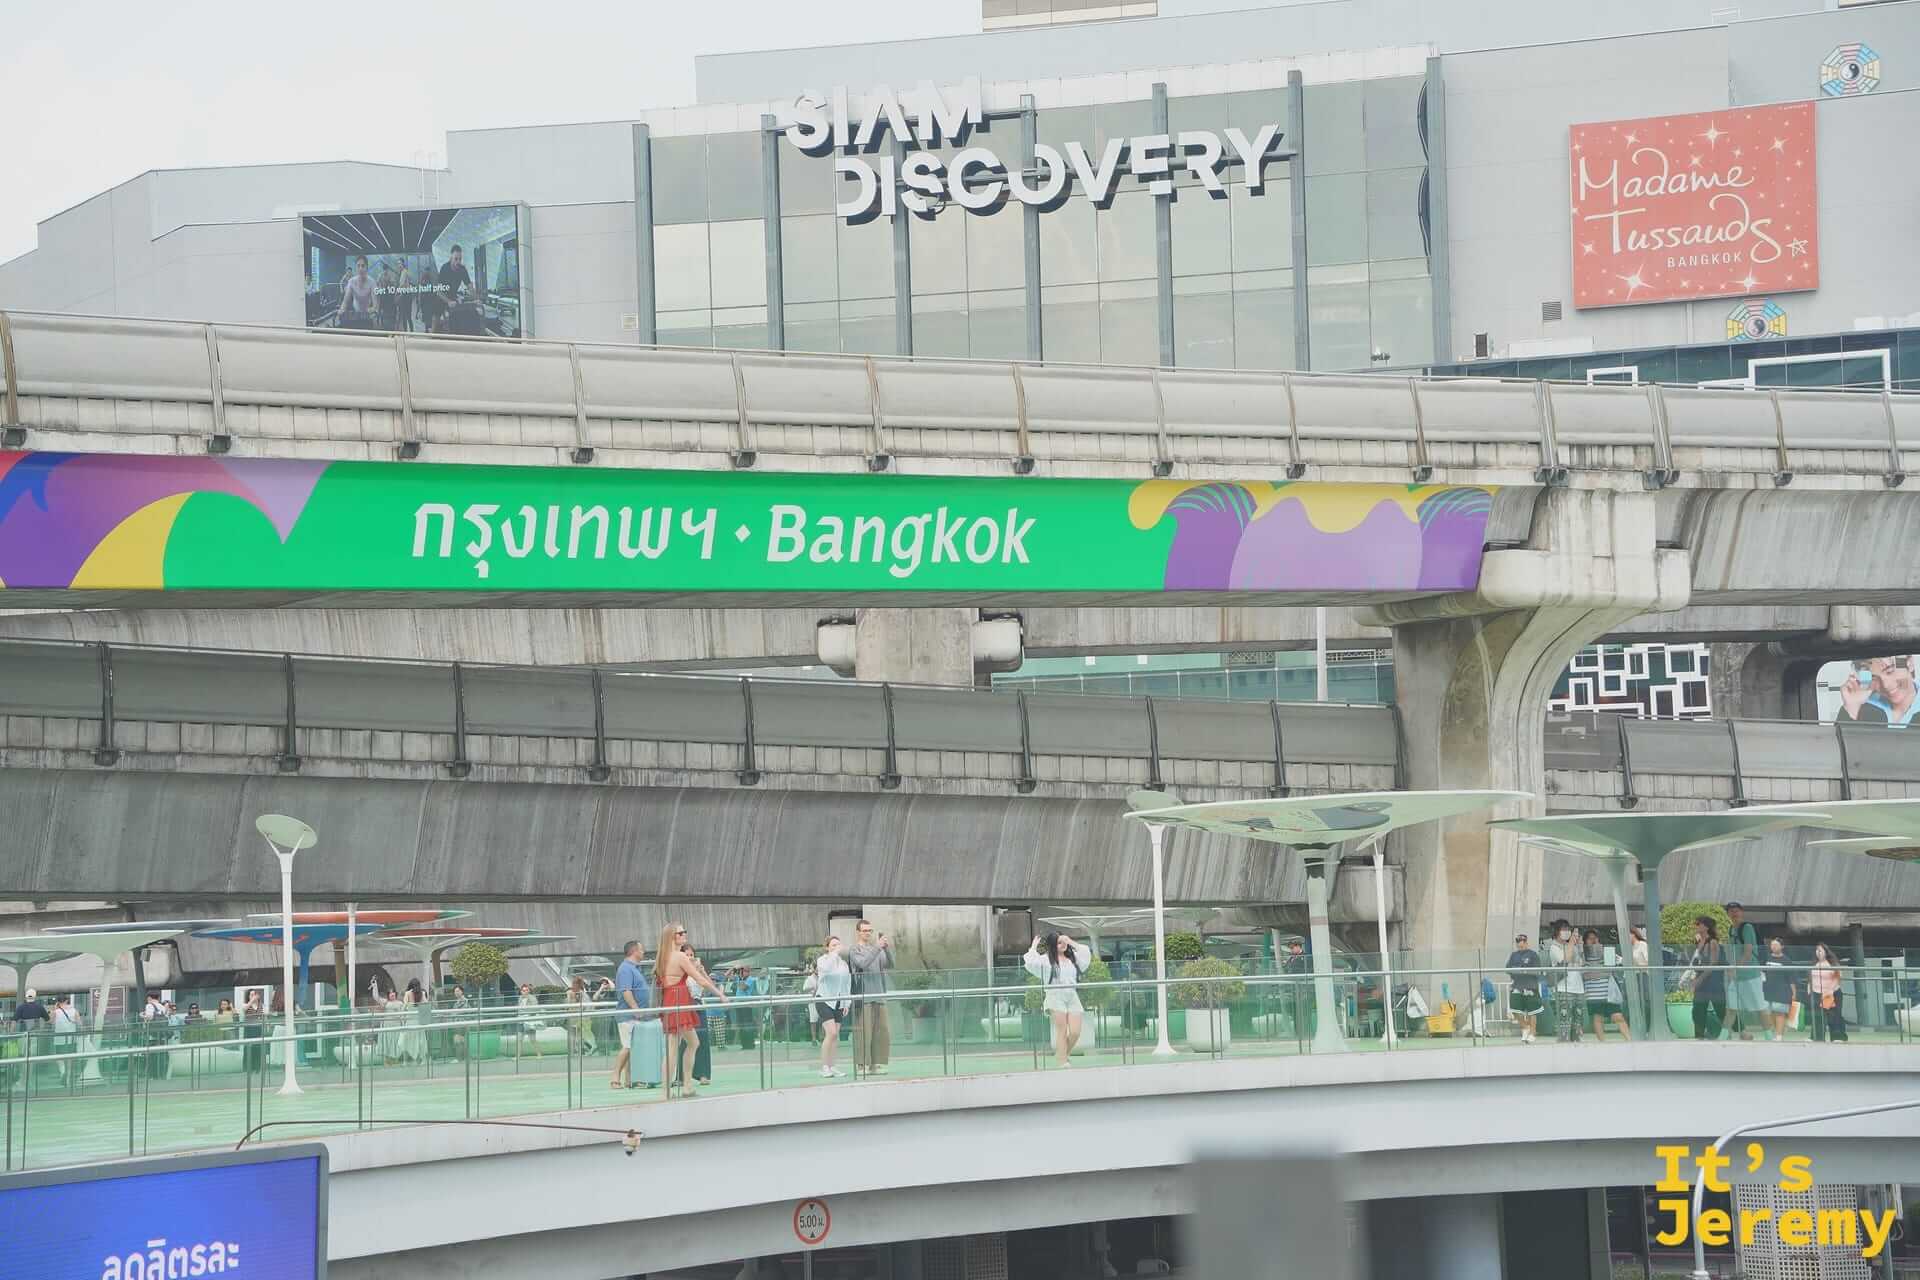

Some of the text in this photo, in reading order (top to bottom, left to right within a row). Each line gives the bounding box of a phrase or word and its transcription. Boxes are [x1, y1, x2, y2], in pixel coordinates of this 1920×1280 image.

[786, 73, 983, 149] SIAM
[835, 122, 1280, 217] DISCOVERY
[1579, 148, 1755, 205] Madame
[1584, 193, 1782, 264] Tussauds
[1667, 251, 1743, 268] BANGKOK
[387, 285, 396, 294] 10
[419, 283, 432, 293] half
[432, 282, 450, 295] price
[412, 503, 1037, 578] กรุงเทพฯ Bangkok
[799, 1214, 817, 1229] 5.00
